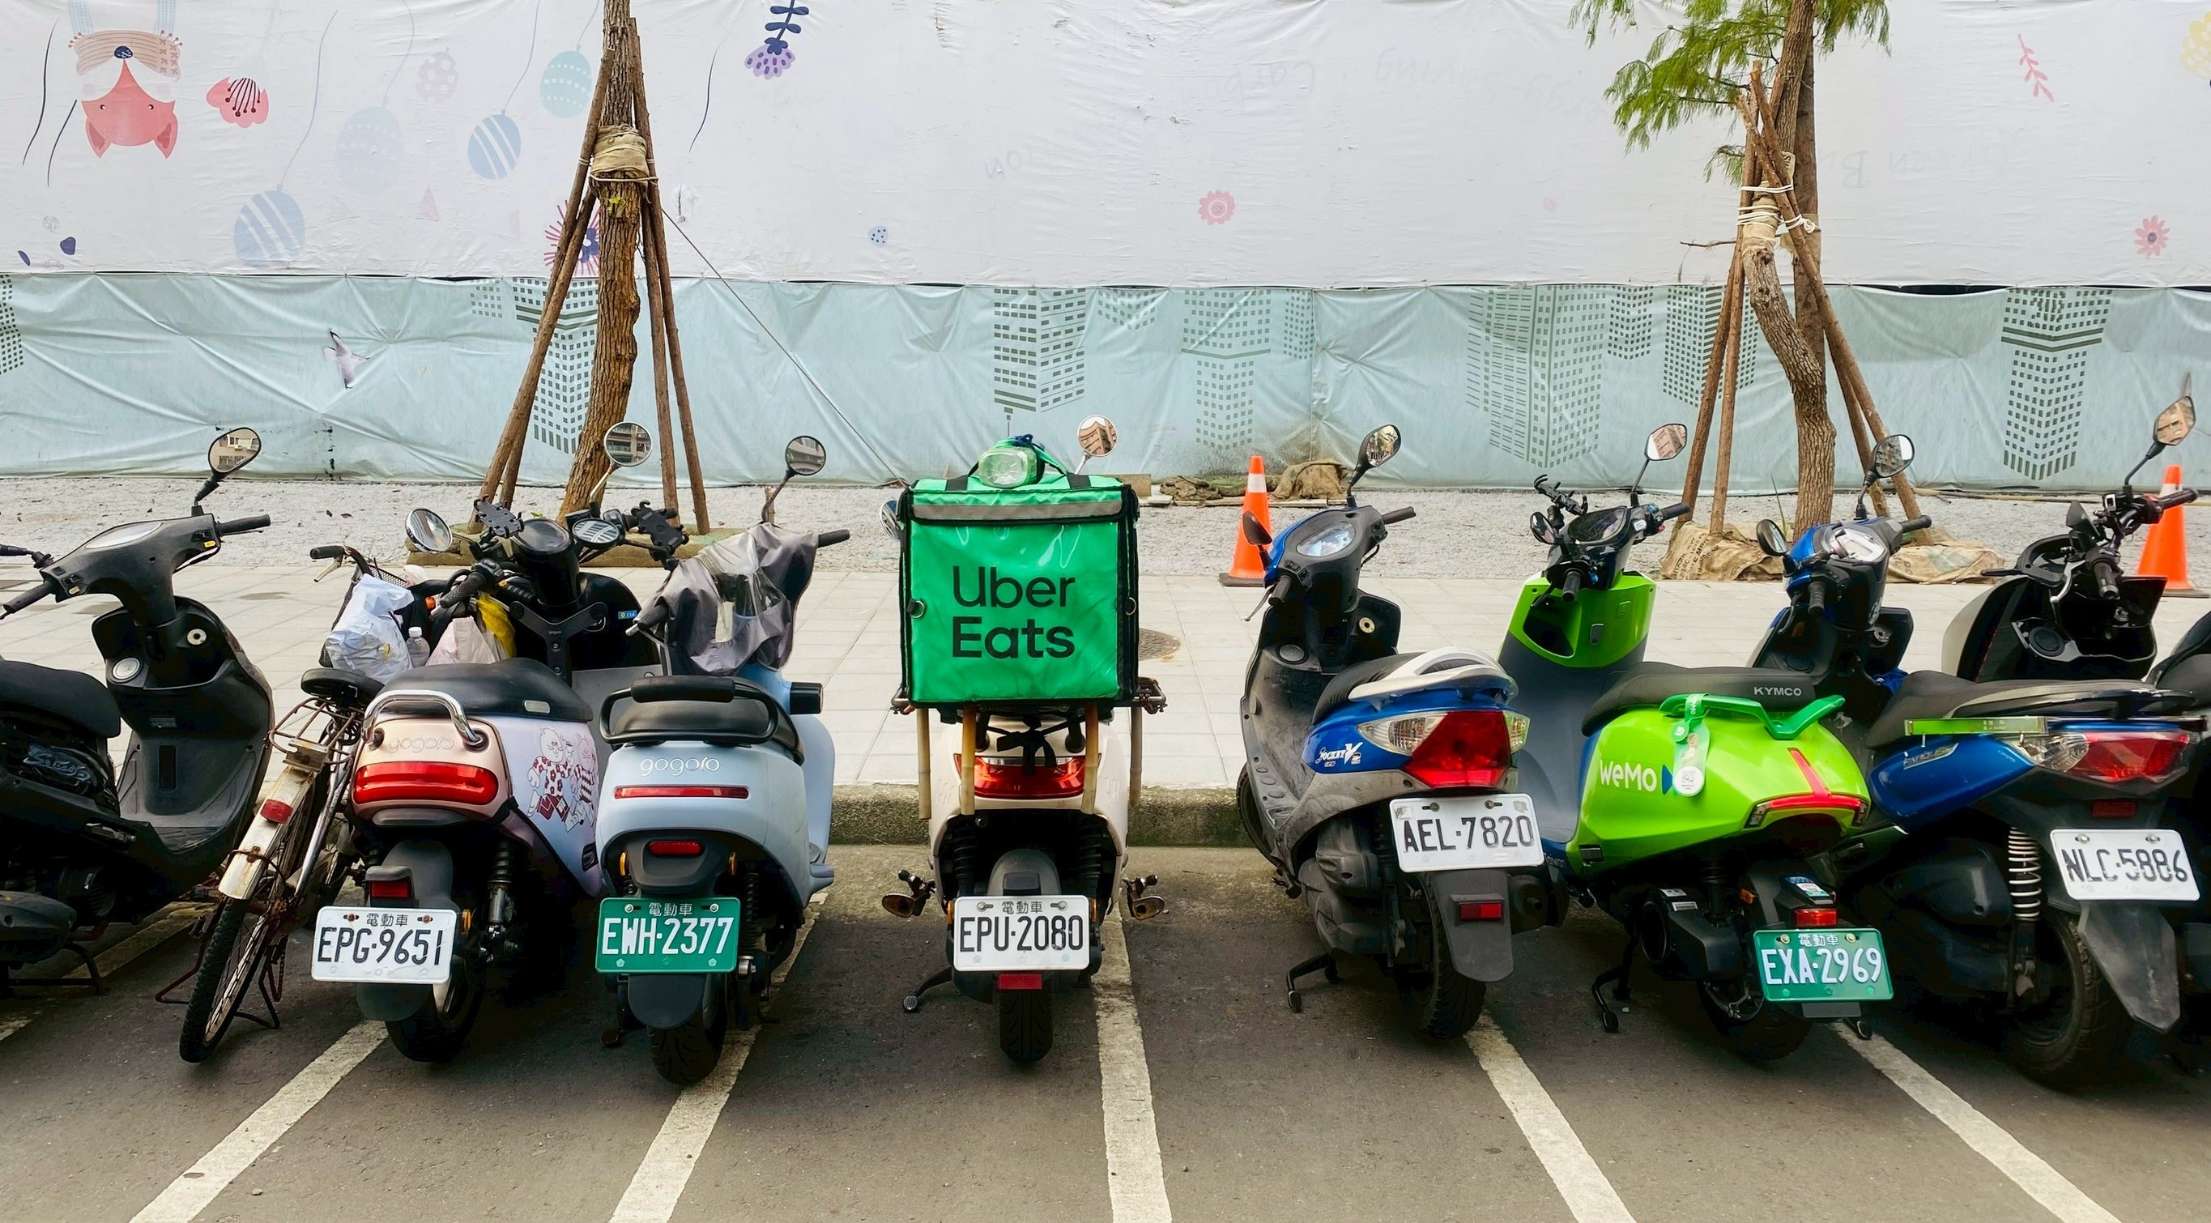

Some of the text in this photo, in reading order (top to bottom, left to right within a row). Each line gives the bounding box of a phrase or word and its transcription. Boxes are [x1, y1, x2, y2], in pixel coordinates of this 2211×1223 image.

[953, 565, 1076, 608] Uber
[952, 616, 1075, 659] Eats
[1753, 686, 1802, 697] KYMCO
[640, 756, 720, 777] gogoro
[1600, 759, 1658, 792] WeMo
[648, 902, 693, 917] 電動車
[1001, 900, 1043, 915] 電動車
[366, 912, 409, 928] 電動車
